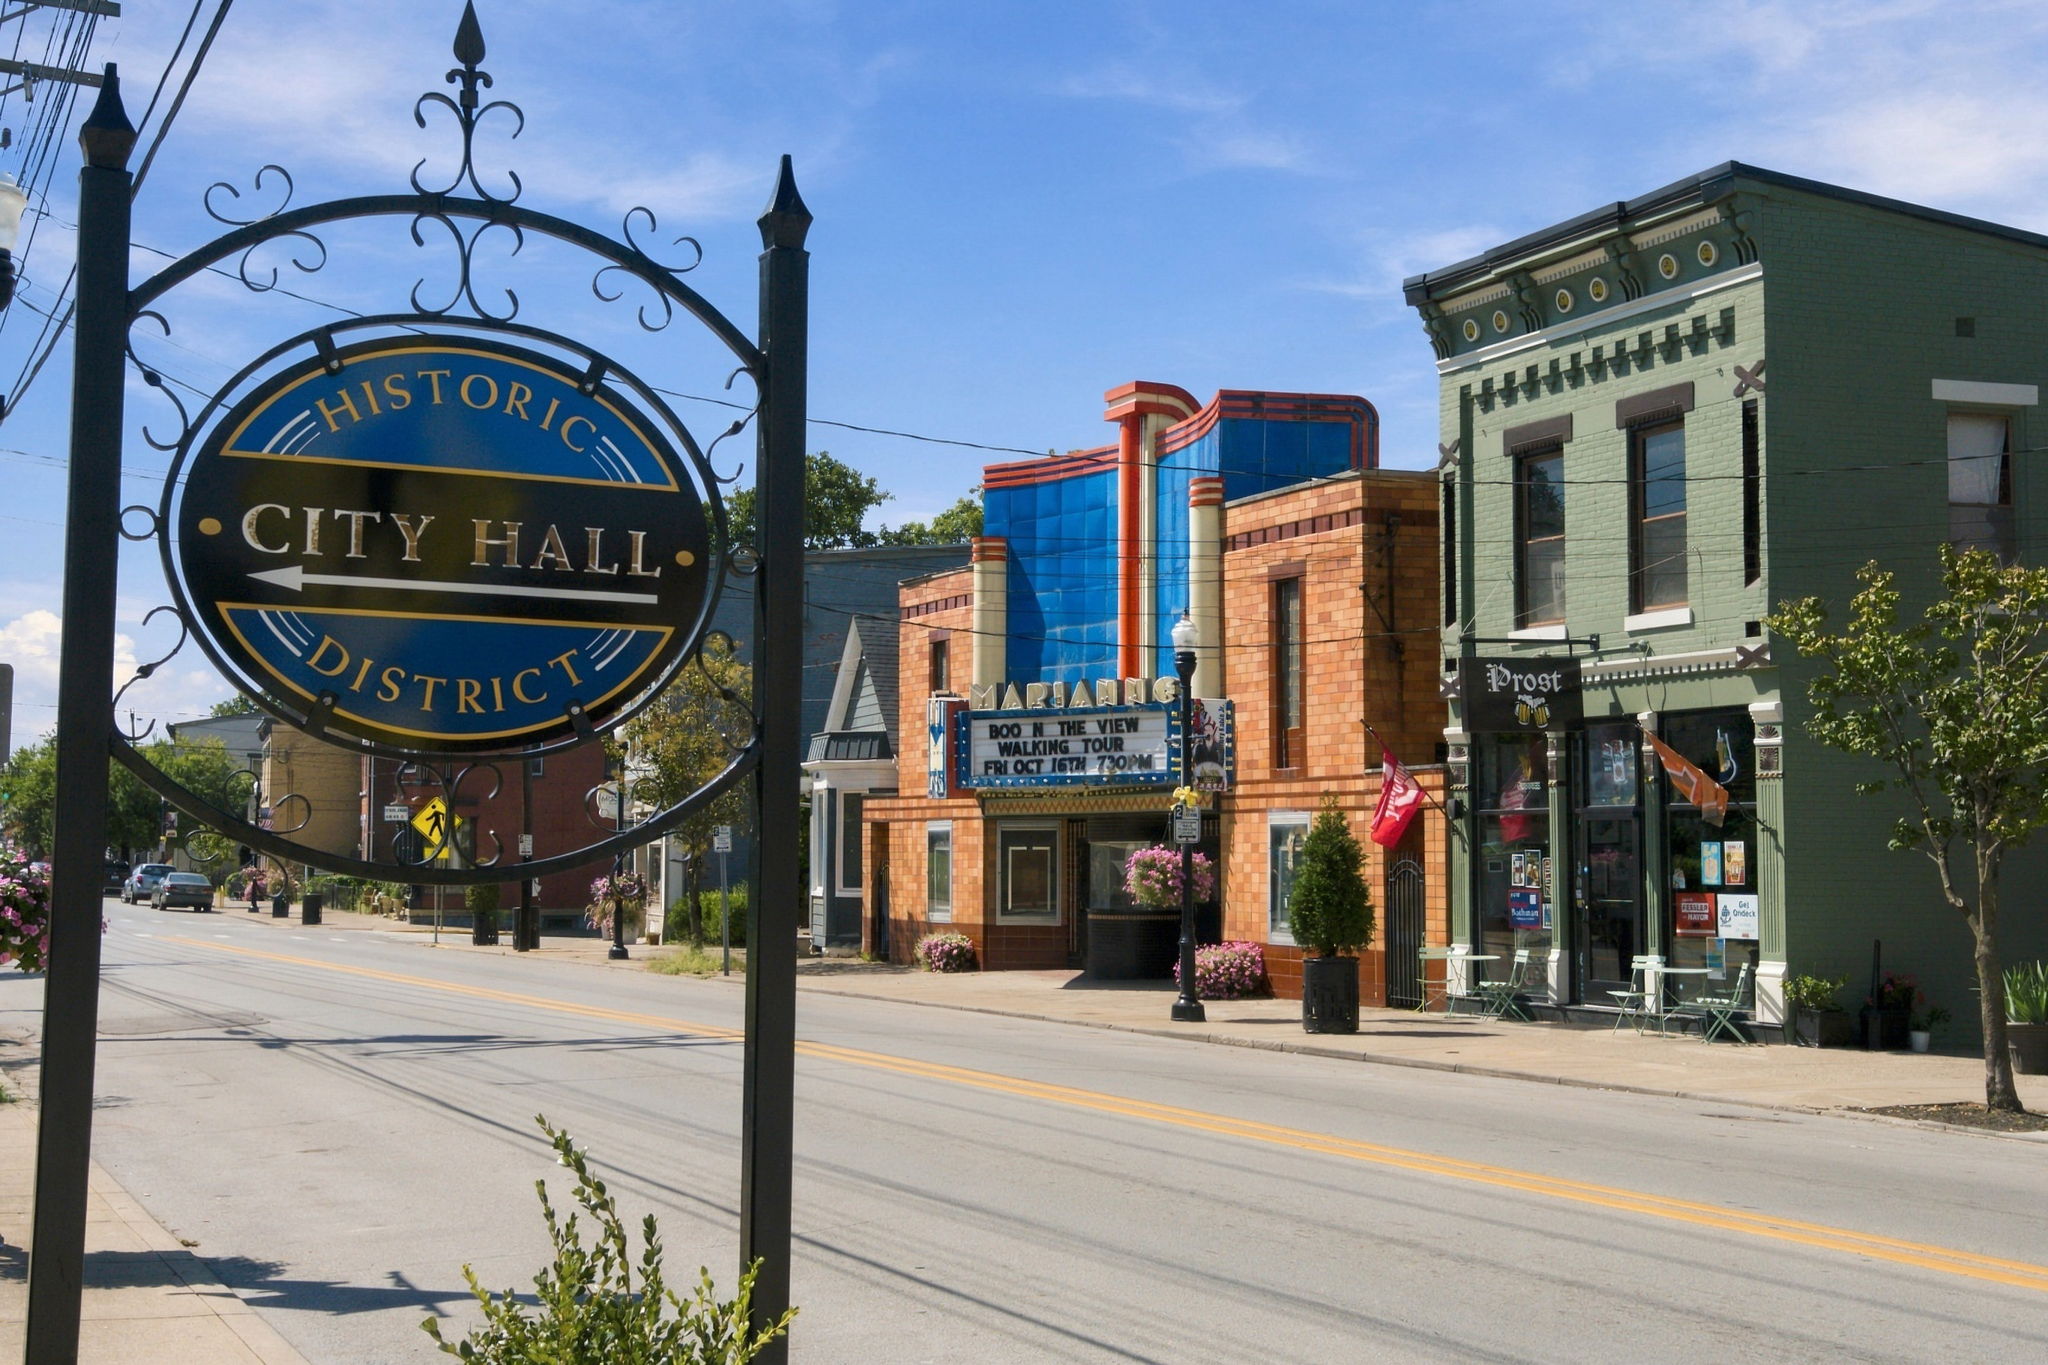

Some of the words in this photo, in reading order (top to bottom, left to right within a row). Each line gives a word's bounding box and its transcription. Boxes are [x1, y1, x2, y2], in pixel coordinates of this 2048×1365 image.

[315, 369, 597, 453] HISTORIC
[241, 502, 435, 562] CITY
[470, 518, 661, 578] HALL
[306, 635, 585, 714] DISTRICT
[1485, 662, 1562, 692] Prost
[989, 723, 1022, 740] BOO
[1032, 721, 1044, 737] N
[1057, 720, 1087, 736] THE
[1096, 717, 1140, 735] VIEW
[997, 739, 1070, 757] WALKING
[1082, 737, 1125, 754] TOUR
[983, 760, 1008, 775] FRI
[1013, 758, 1044, 775] OCT
[1051, 756, 1087, 773] 16TH
